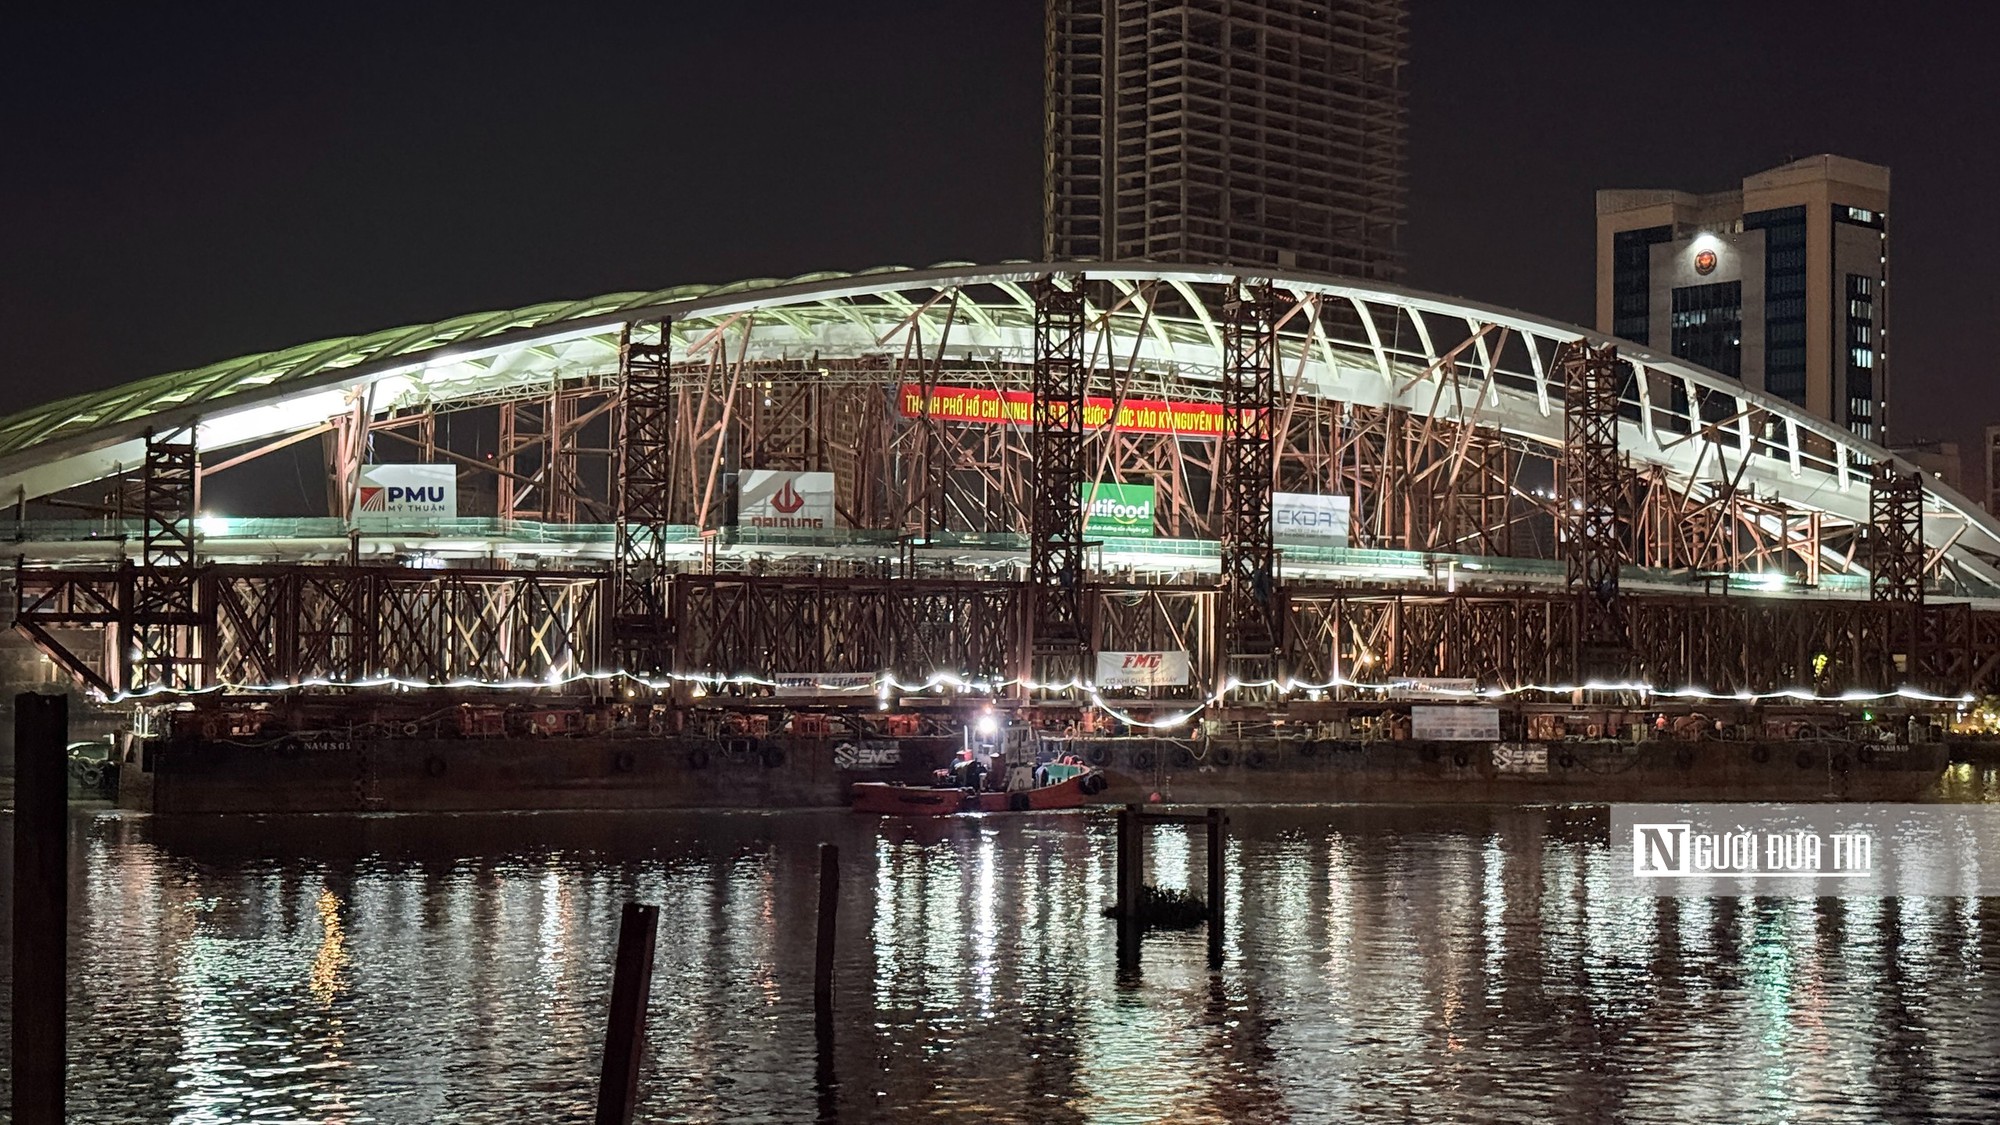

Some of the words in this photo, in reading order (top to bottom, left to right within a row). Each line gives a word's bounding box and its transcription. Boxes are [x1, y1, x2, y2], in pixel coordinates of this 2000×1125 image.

[906, 395, 940, 414] THH
[943, 393, 965, 416] PHỐ
[966, 394, 981, 417] HỒ
[982, 398, 1000, 419] CHÍ
[1137, 407, 1156, 428] VÀO
[1174, 410, 1213, 432] NGUYÊN
[388, 486, 445, 502] PMU
[388, 504, 403, 512] MỸ
[409, 503, 445, 513] THUẬN
[1081, 498, 1150, 519] utifood
